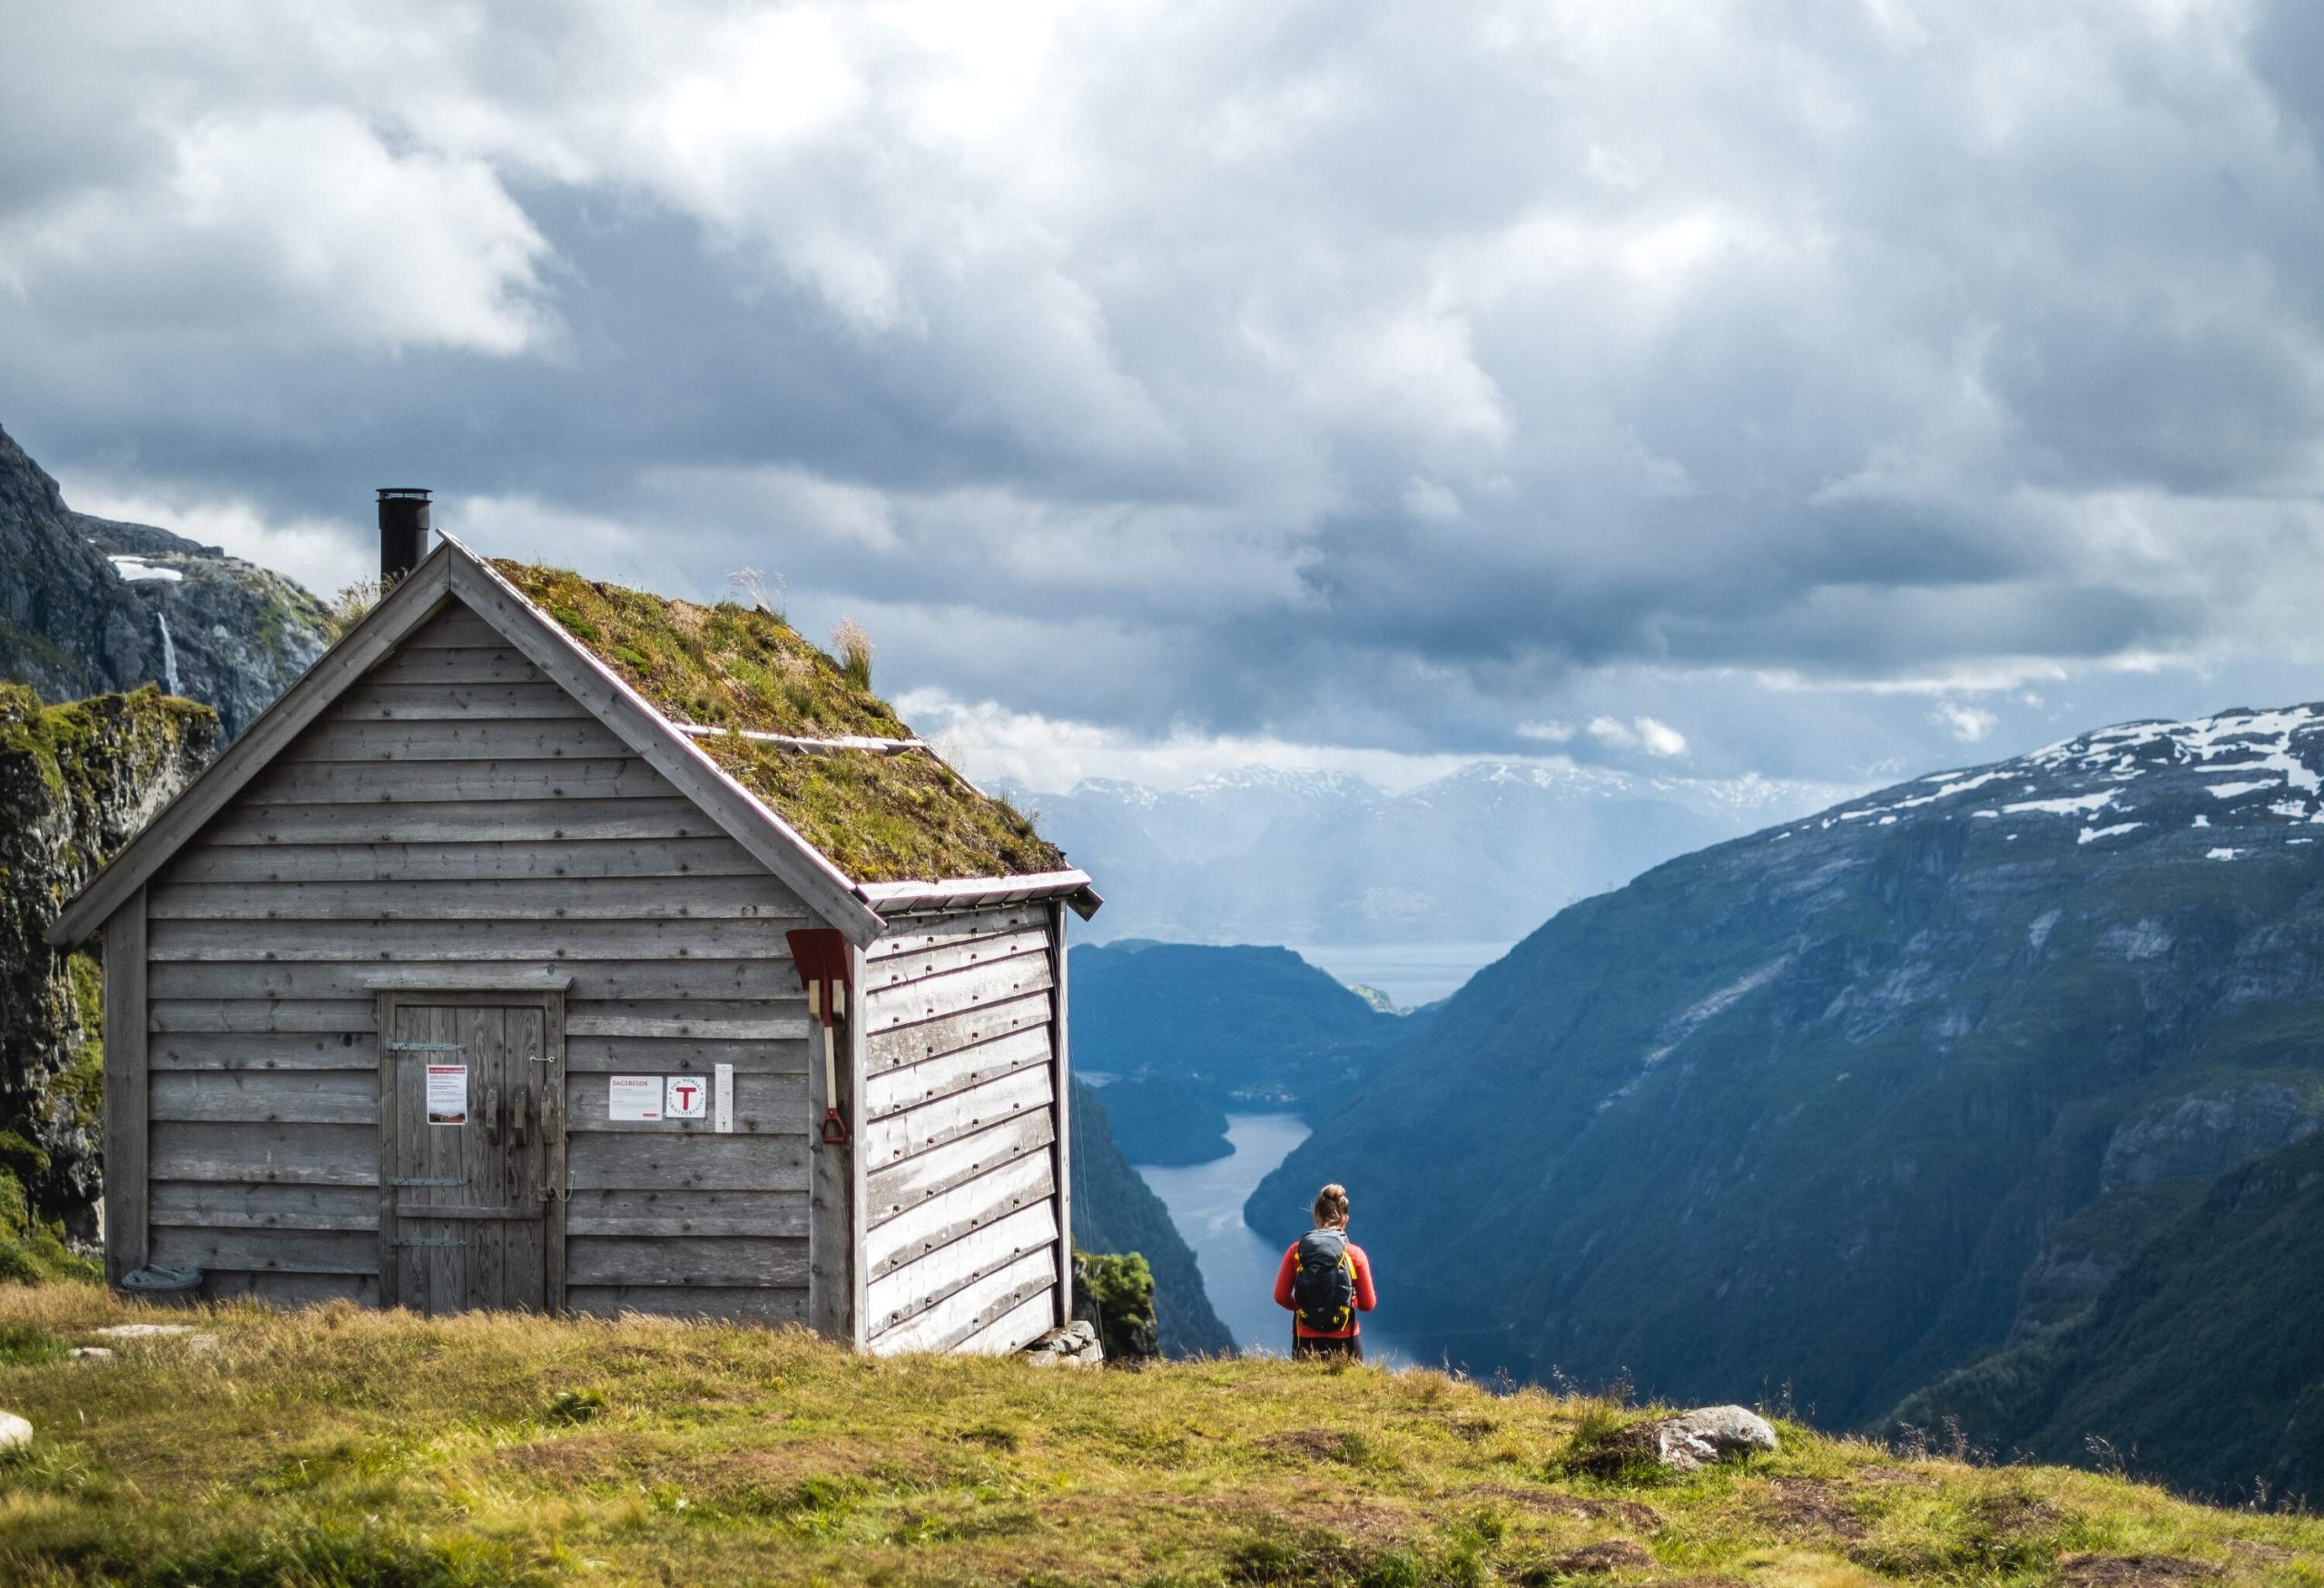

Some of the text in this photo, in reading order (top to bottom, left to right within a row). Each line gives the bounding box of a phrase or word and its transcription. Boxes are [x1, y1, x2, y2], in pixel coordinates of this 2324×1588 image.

[670, 1078, 703, 1090] DEN NORSKE
[675, 1086, 697, 1111] T
